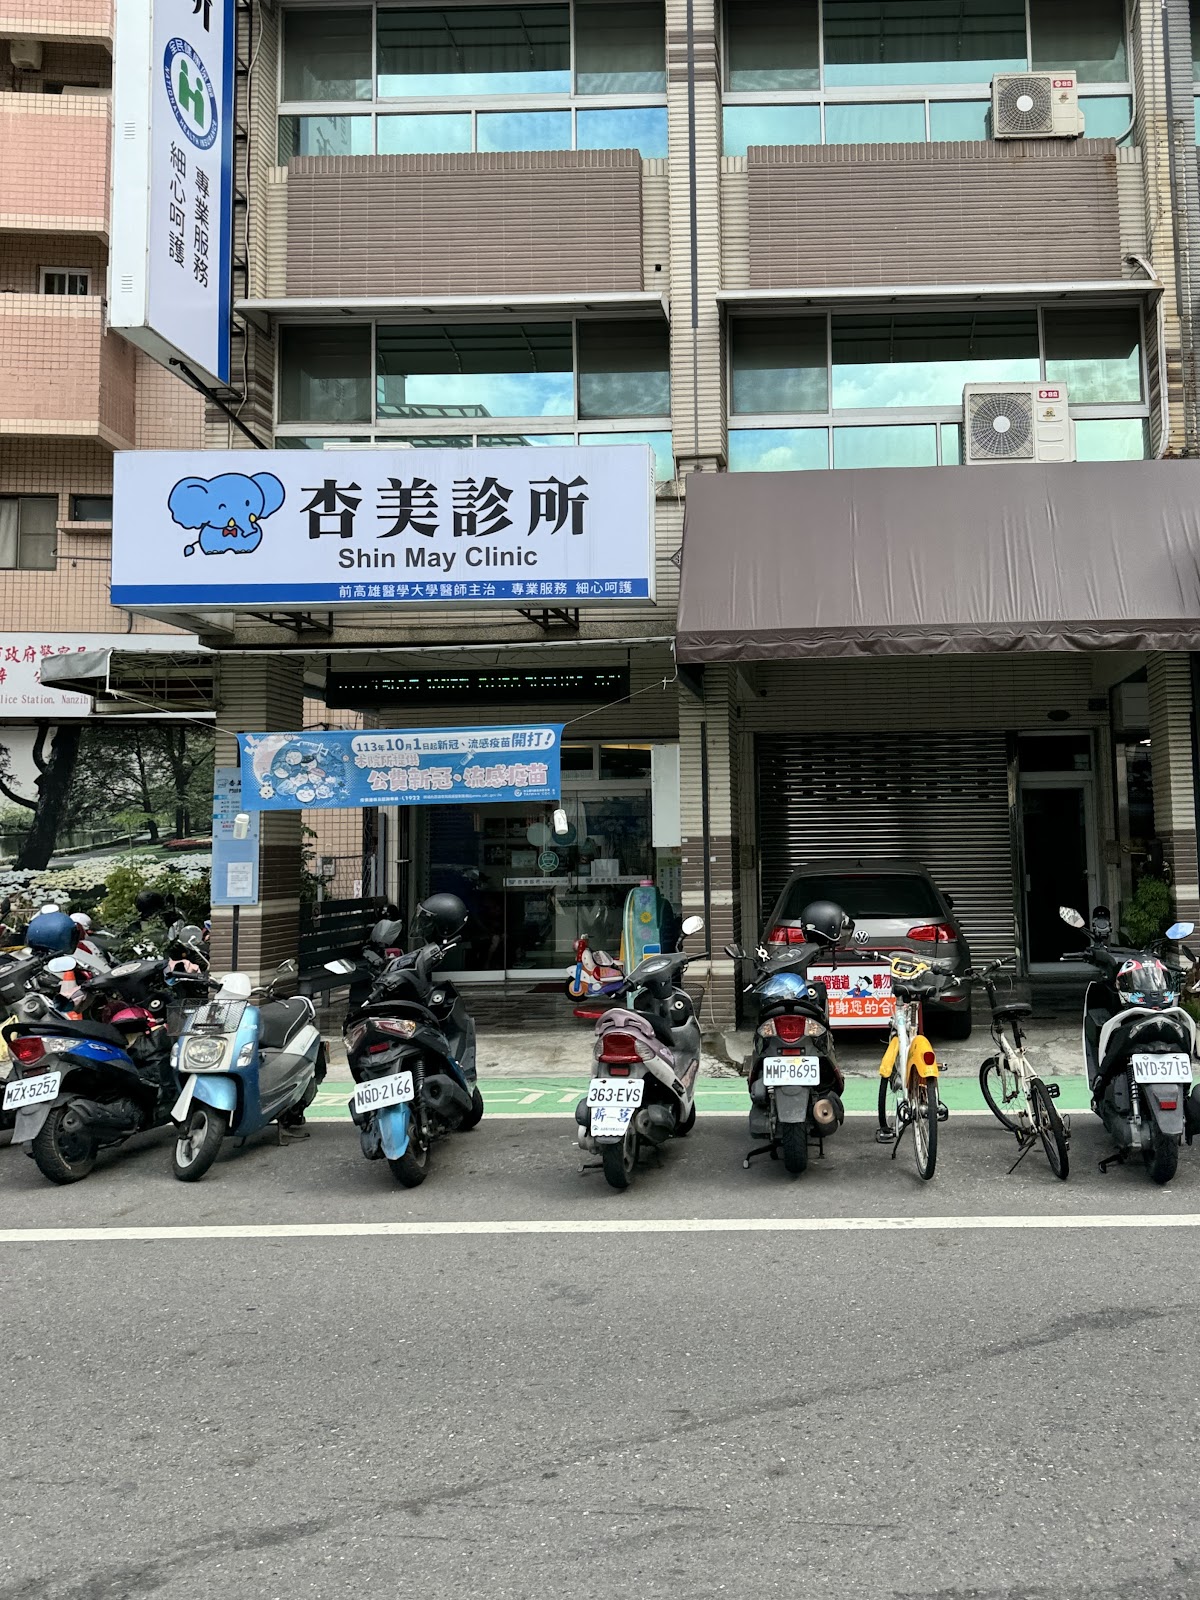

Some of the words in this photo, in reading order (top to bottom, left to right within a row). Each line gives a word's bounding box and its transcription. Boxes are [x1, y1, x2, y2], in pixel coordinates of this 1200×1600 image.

[164, 66, 181, 119] NATIONAL
[179, 119, 200, 145] HEALTH
[169, 141, 186, 268] 細心呵護
[193, 165, 210, 288] 專業服務
[299, 475, 589, 540] 杏美診所
[338, 548, 396, 569] Shin
[404, 547, 457, 572] May
[465, 546, 539, 567] Clinic
[575, 581, 632, 594] 細心呵護
